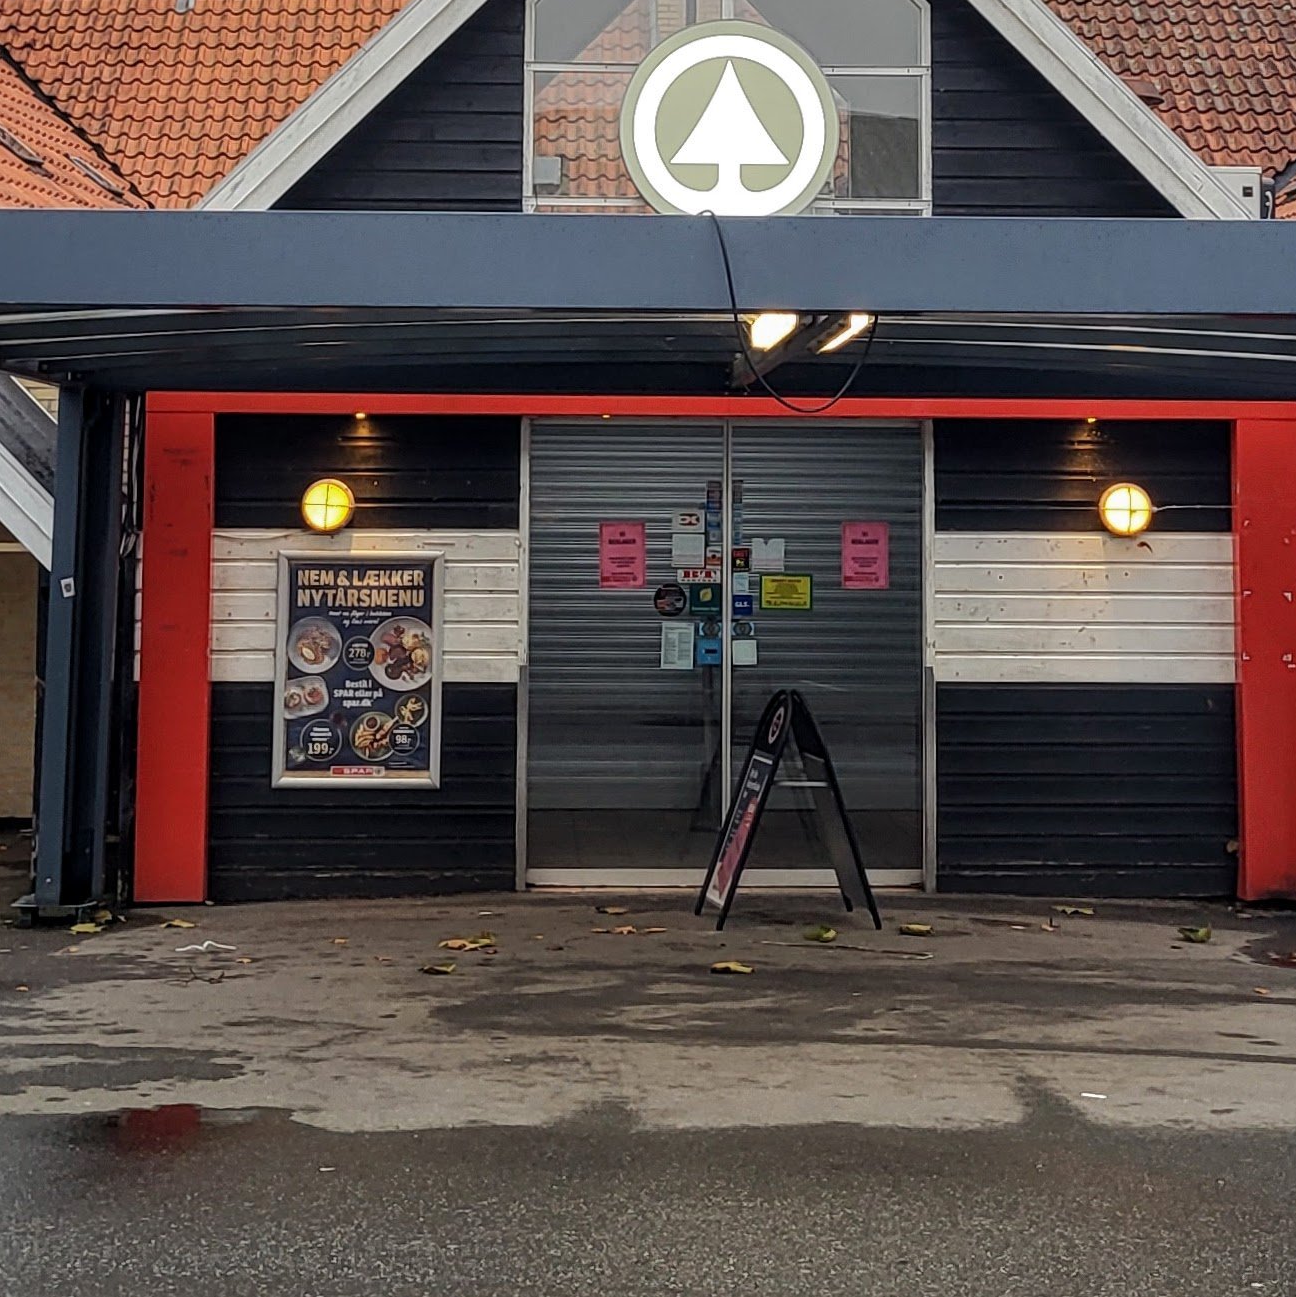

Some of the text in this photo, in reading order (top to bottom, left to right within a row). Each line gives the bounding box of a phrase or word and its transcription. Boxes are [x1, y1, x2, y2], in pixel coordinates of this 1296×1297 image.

[297, 569, 424, 586] NEM & LÆKKER
[297, 588, 424, 607] NYTÅRSMENU
[345, 680, 368, 688] Bestil
[333, 689, 354, 698] SPAR
[373, 689, 384, 700] på
[343, 768, 373, 776] SPAR
